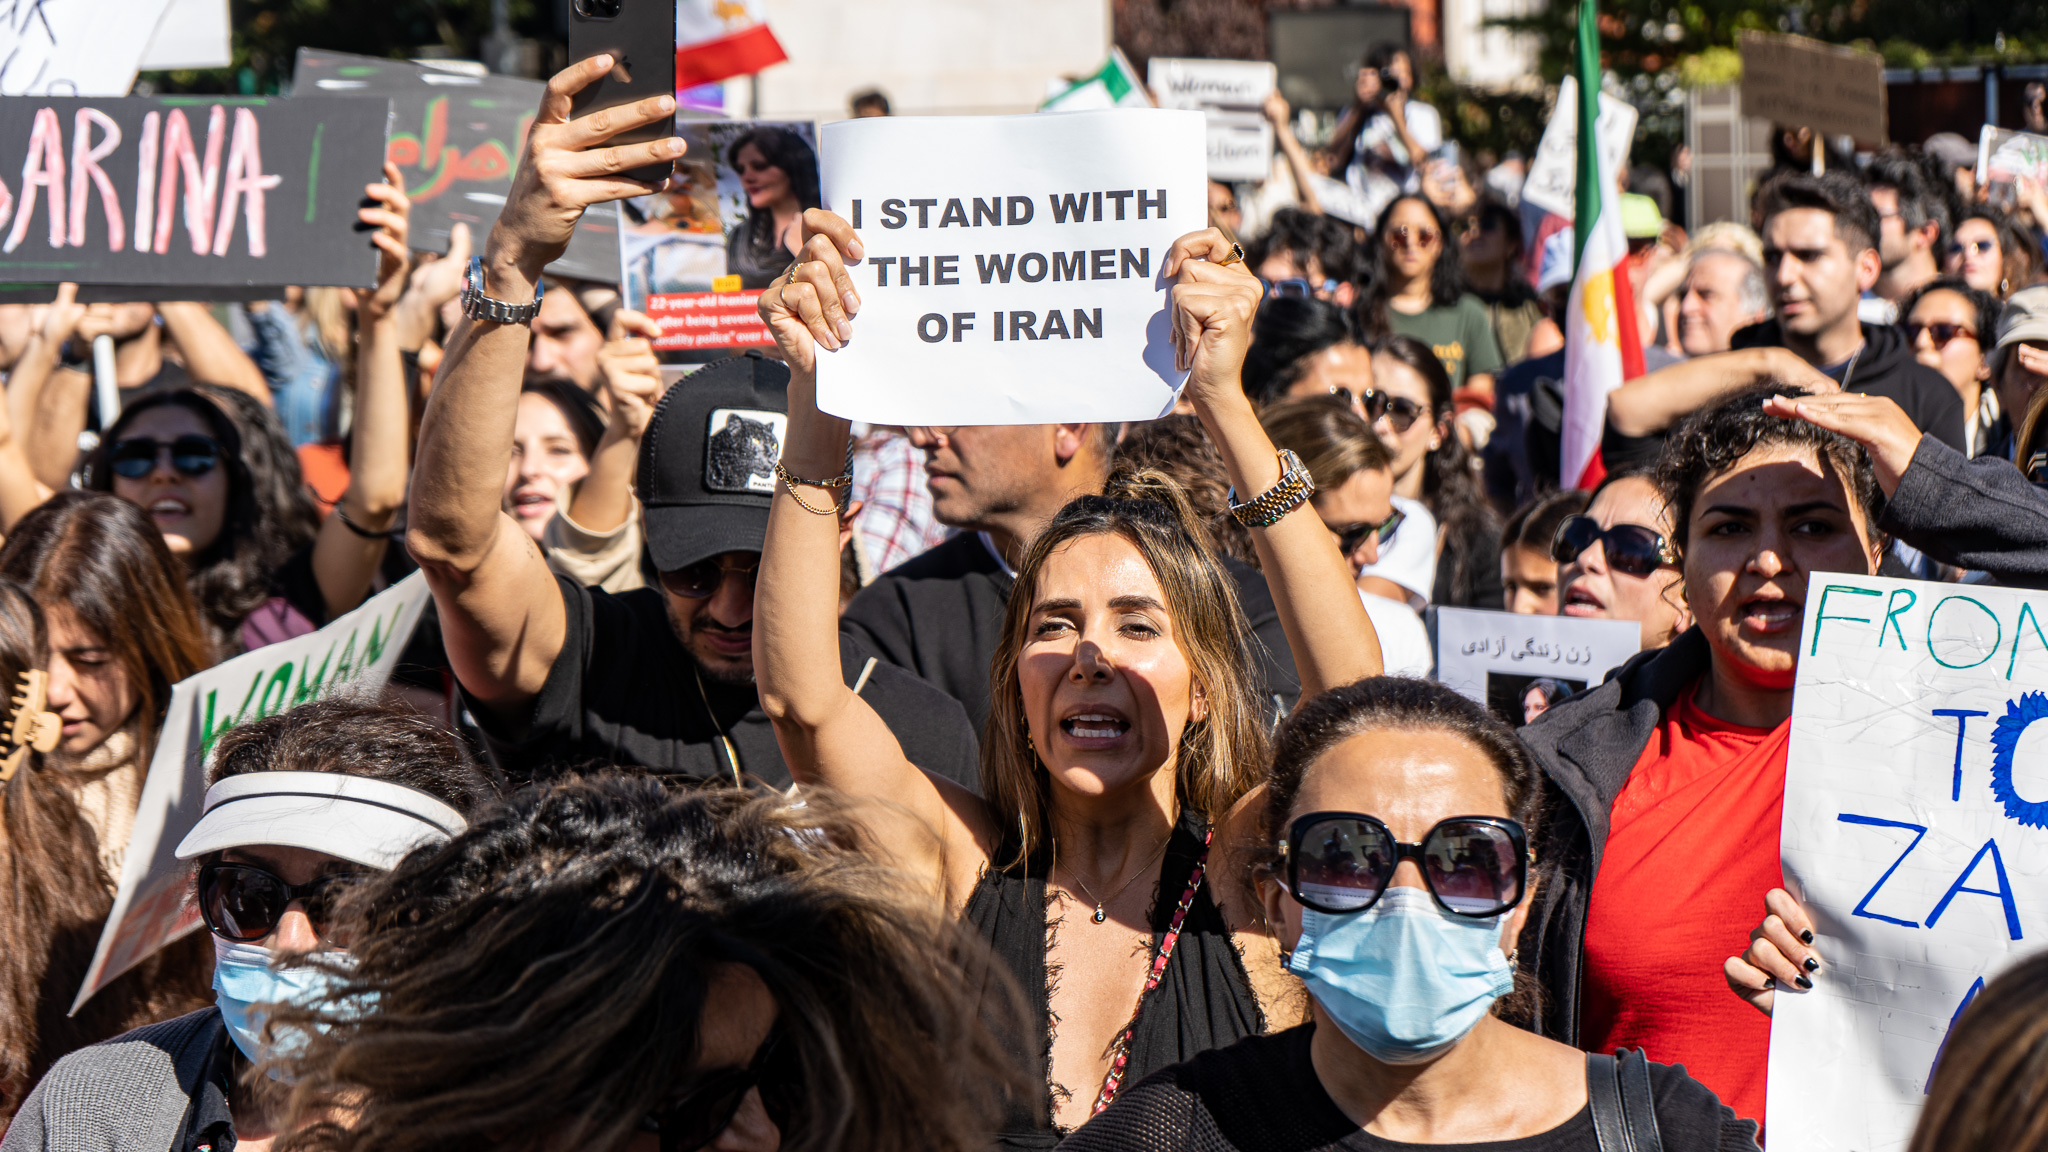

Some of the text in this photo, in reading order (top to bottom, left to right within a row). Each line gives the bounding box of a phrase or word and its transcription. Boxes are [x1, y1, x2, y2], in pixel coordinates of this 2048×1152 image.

[0, 104, 283, 259] ARINA
[853, 189, 1167, 230] I STAND WITH
[869, 247, 1150, 287] THE WOMEN
[652, 335, 694, 348] orality
[736, 333, 762, 344] over
[685, 314, 718, 329] being
[918, 307, 1103, 343] OF IRAN
[1460, 634, 1592, 666] زن زندگی آزادی
[200, 602, 404, 767] WOMAN
